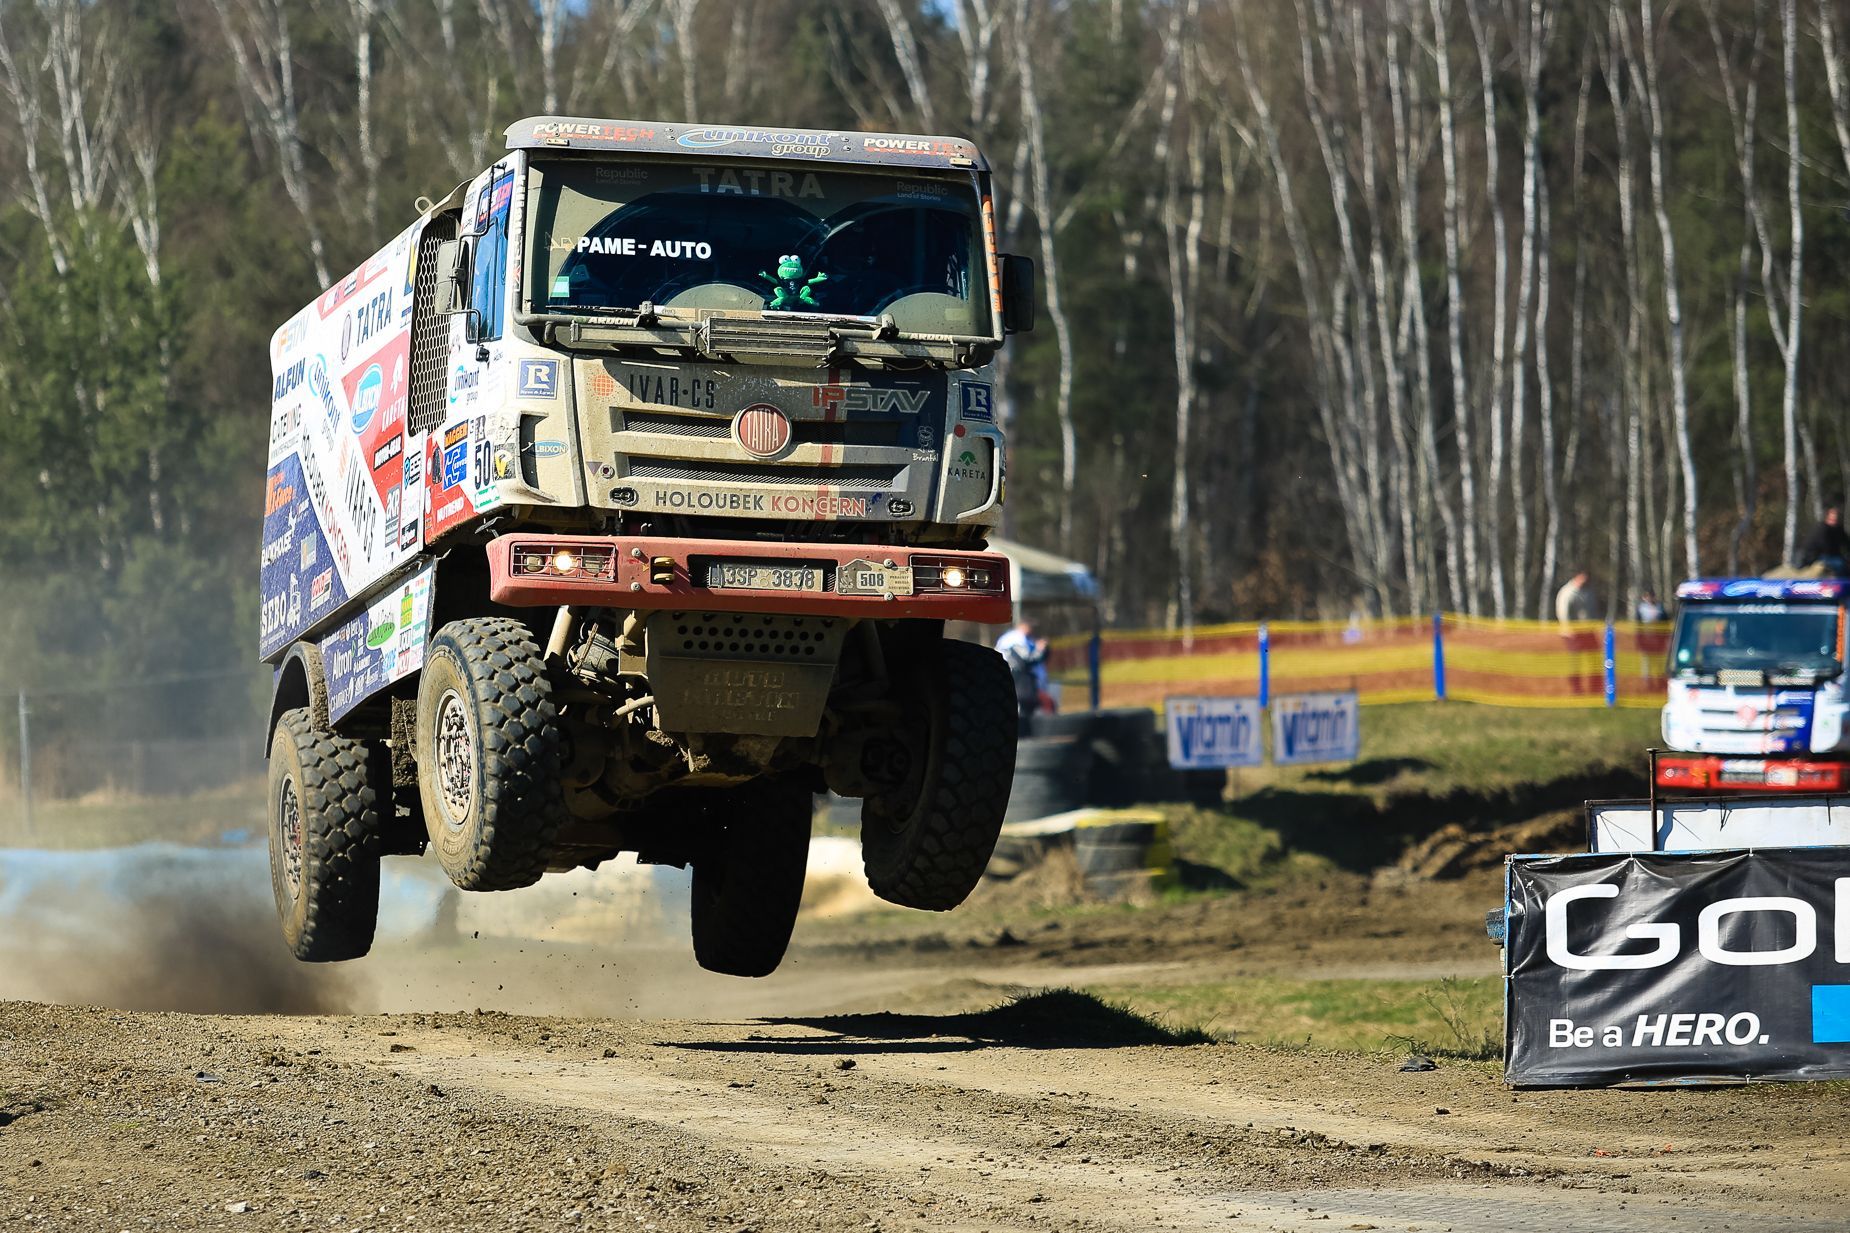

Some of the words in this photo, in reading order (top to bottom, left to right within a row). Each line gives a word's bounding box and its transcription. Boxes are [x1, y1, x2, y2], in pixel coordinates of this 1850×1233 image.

[532, 123, 655, 140] POWERTECH
[703, 128, 832, 145] unikont
[771, 143, 831, 158] group
[595, 167, 648, 180] Republic
[691, 167, 825, 199] TATRA
[896, 181, 949, 195] Republic
[357, 286, 393, 348] TATRA
[588, 316, 635, 327] ARDON
[910, 332, 953, 342] ARDON
[274, 357, 306, 403] ALFUN
[812, 386, 931, 414] IPSTAV
[745, 407, 780, 451] TATRA
[948, 466, 986, 481] KARETA
[655, 490, 764, 512] HOLOUBEK
[771, 493, 866, 518] KONCERN
[725, 567, 757, 586] 3SP
[771, 568, 815, 589] 3838
[860, 572, 885, 588] 508
[1545, 877, 1850, 971] Go
[1548, 1018, 1594, 1048] Be
[1602, 1026, 1623, 1048] a
[1631, 1011, 1770, 1047] HERO.
